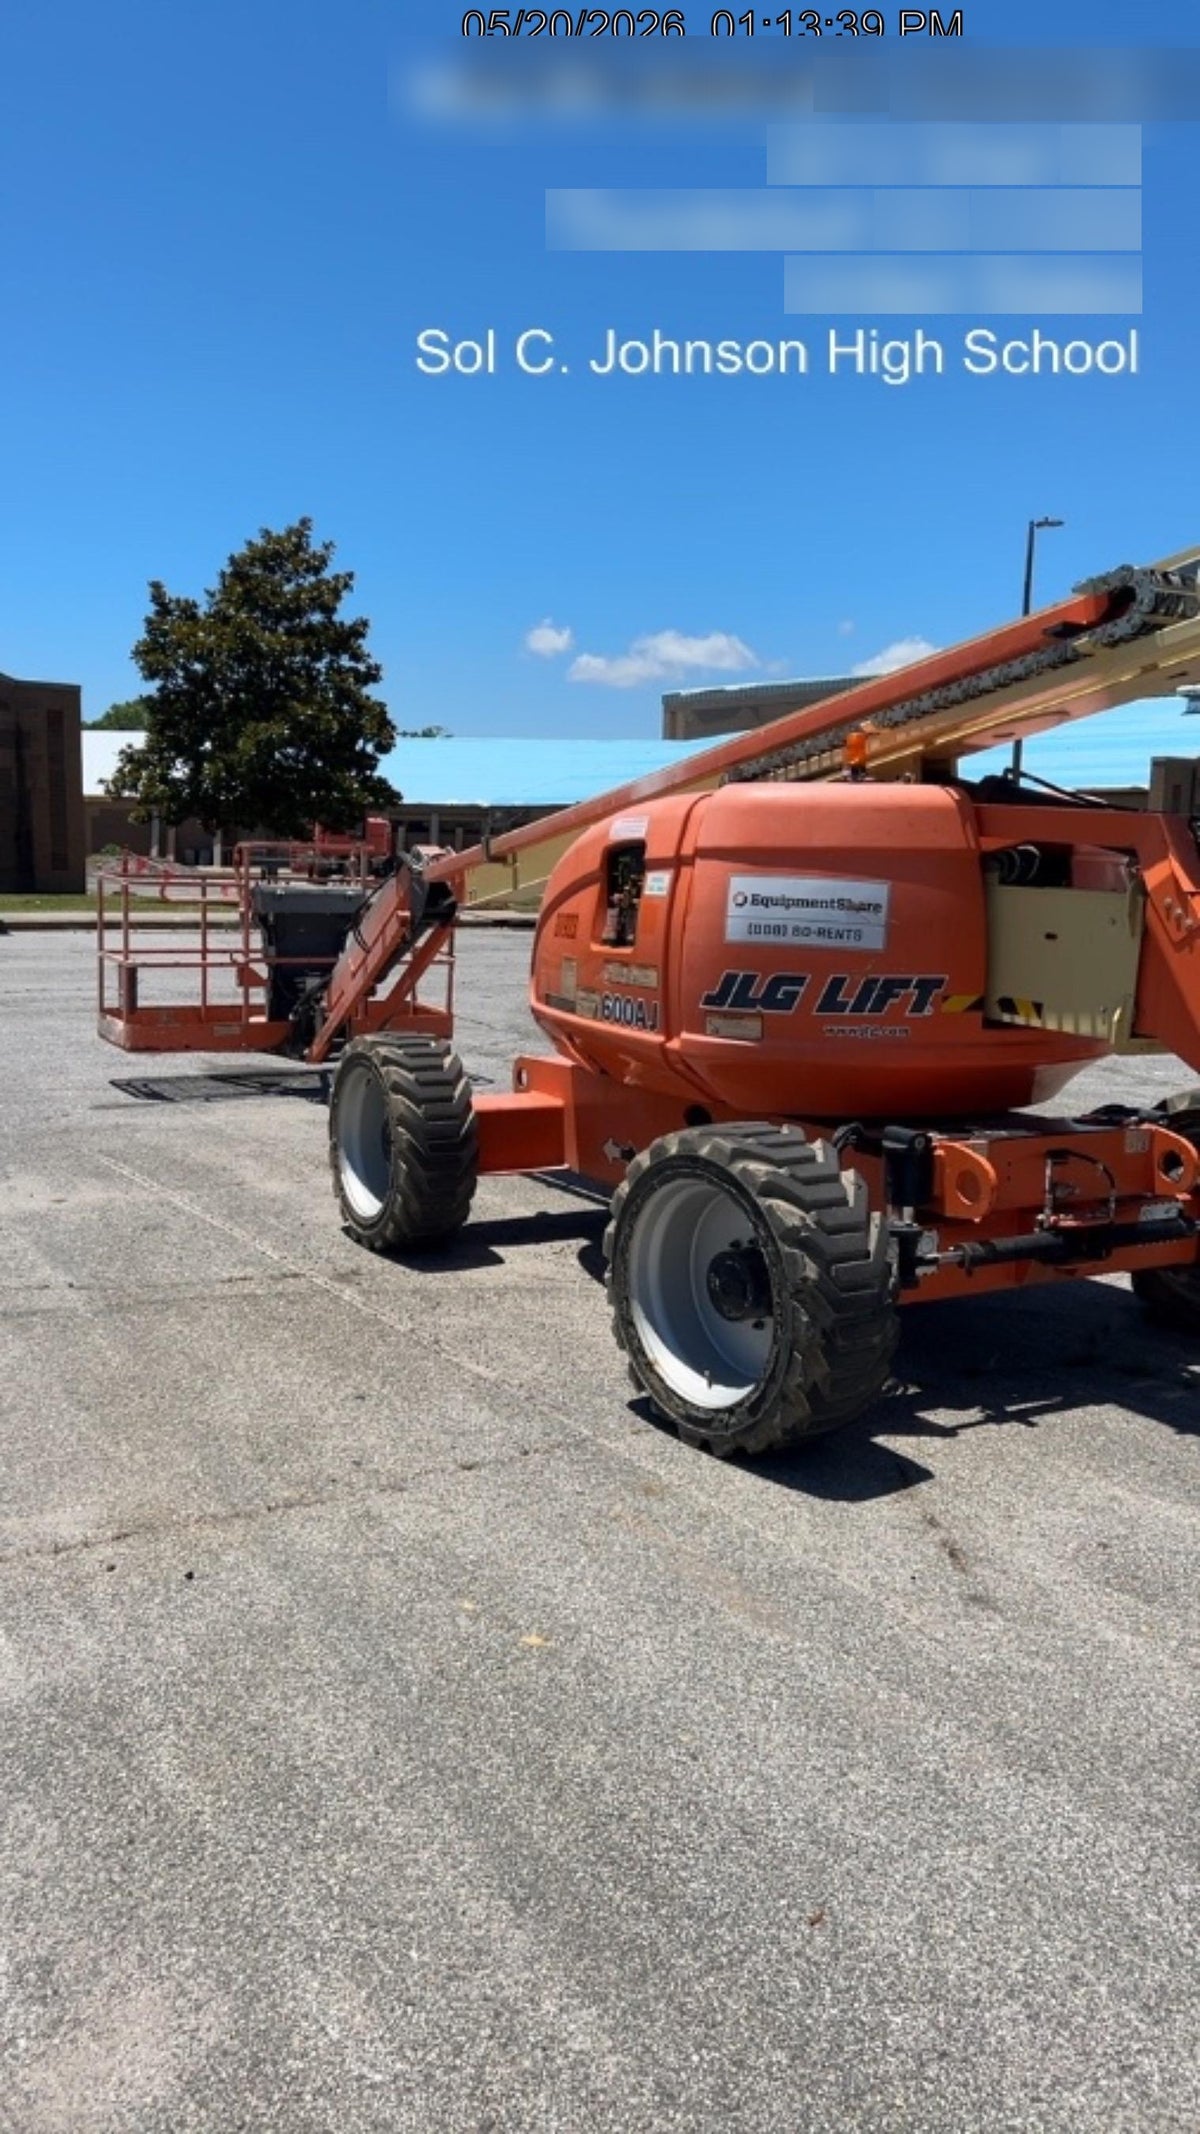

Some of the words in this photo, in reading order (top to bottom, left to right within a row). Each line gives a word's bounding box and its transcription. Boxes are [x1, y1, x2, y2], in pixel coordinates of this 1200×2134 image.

[750, 894, 883, 914] EquipmentShare
[601, 991, 659, 1032] 600AJ
[700, 969, 811, 1014] JLG
[813, 974, 948, 1018] LIFT
